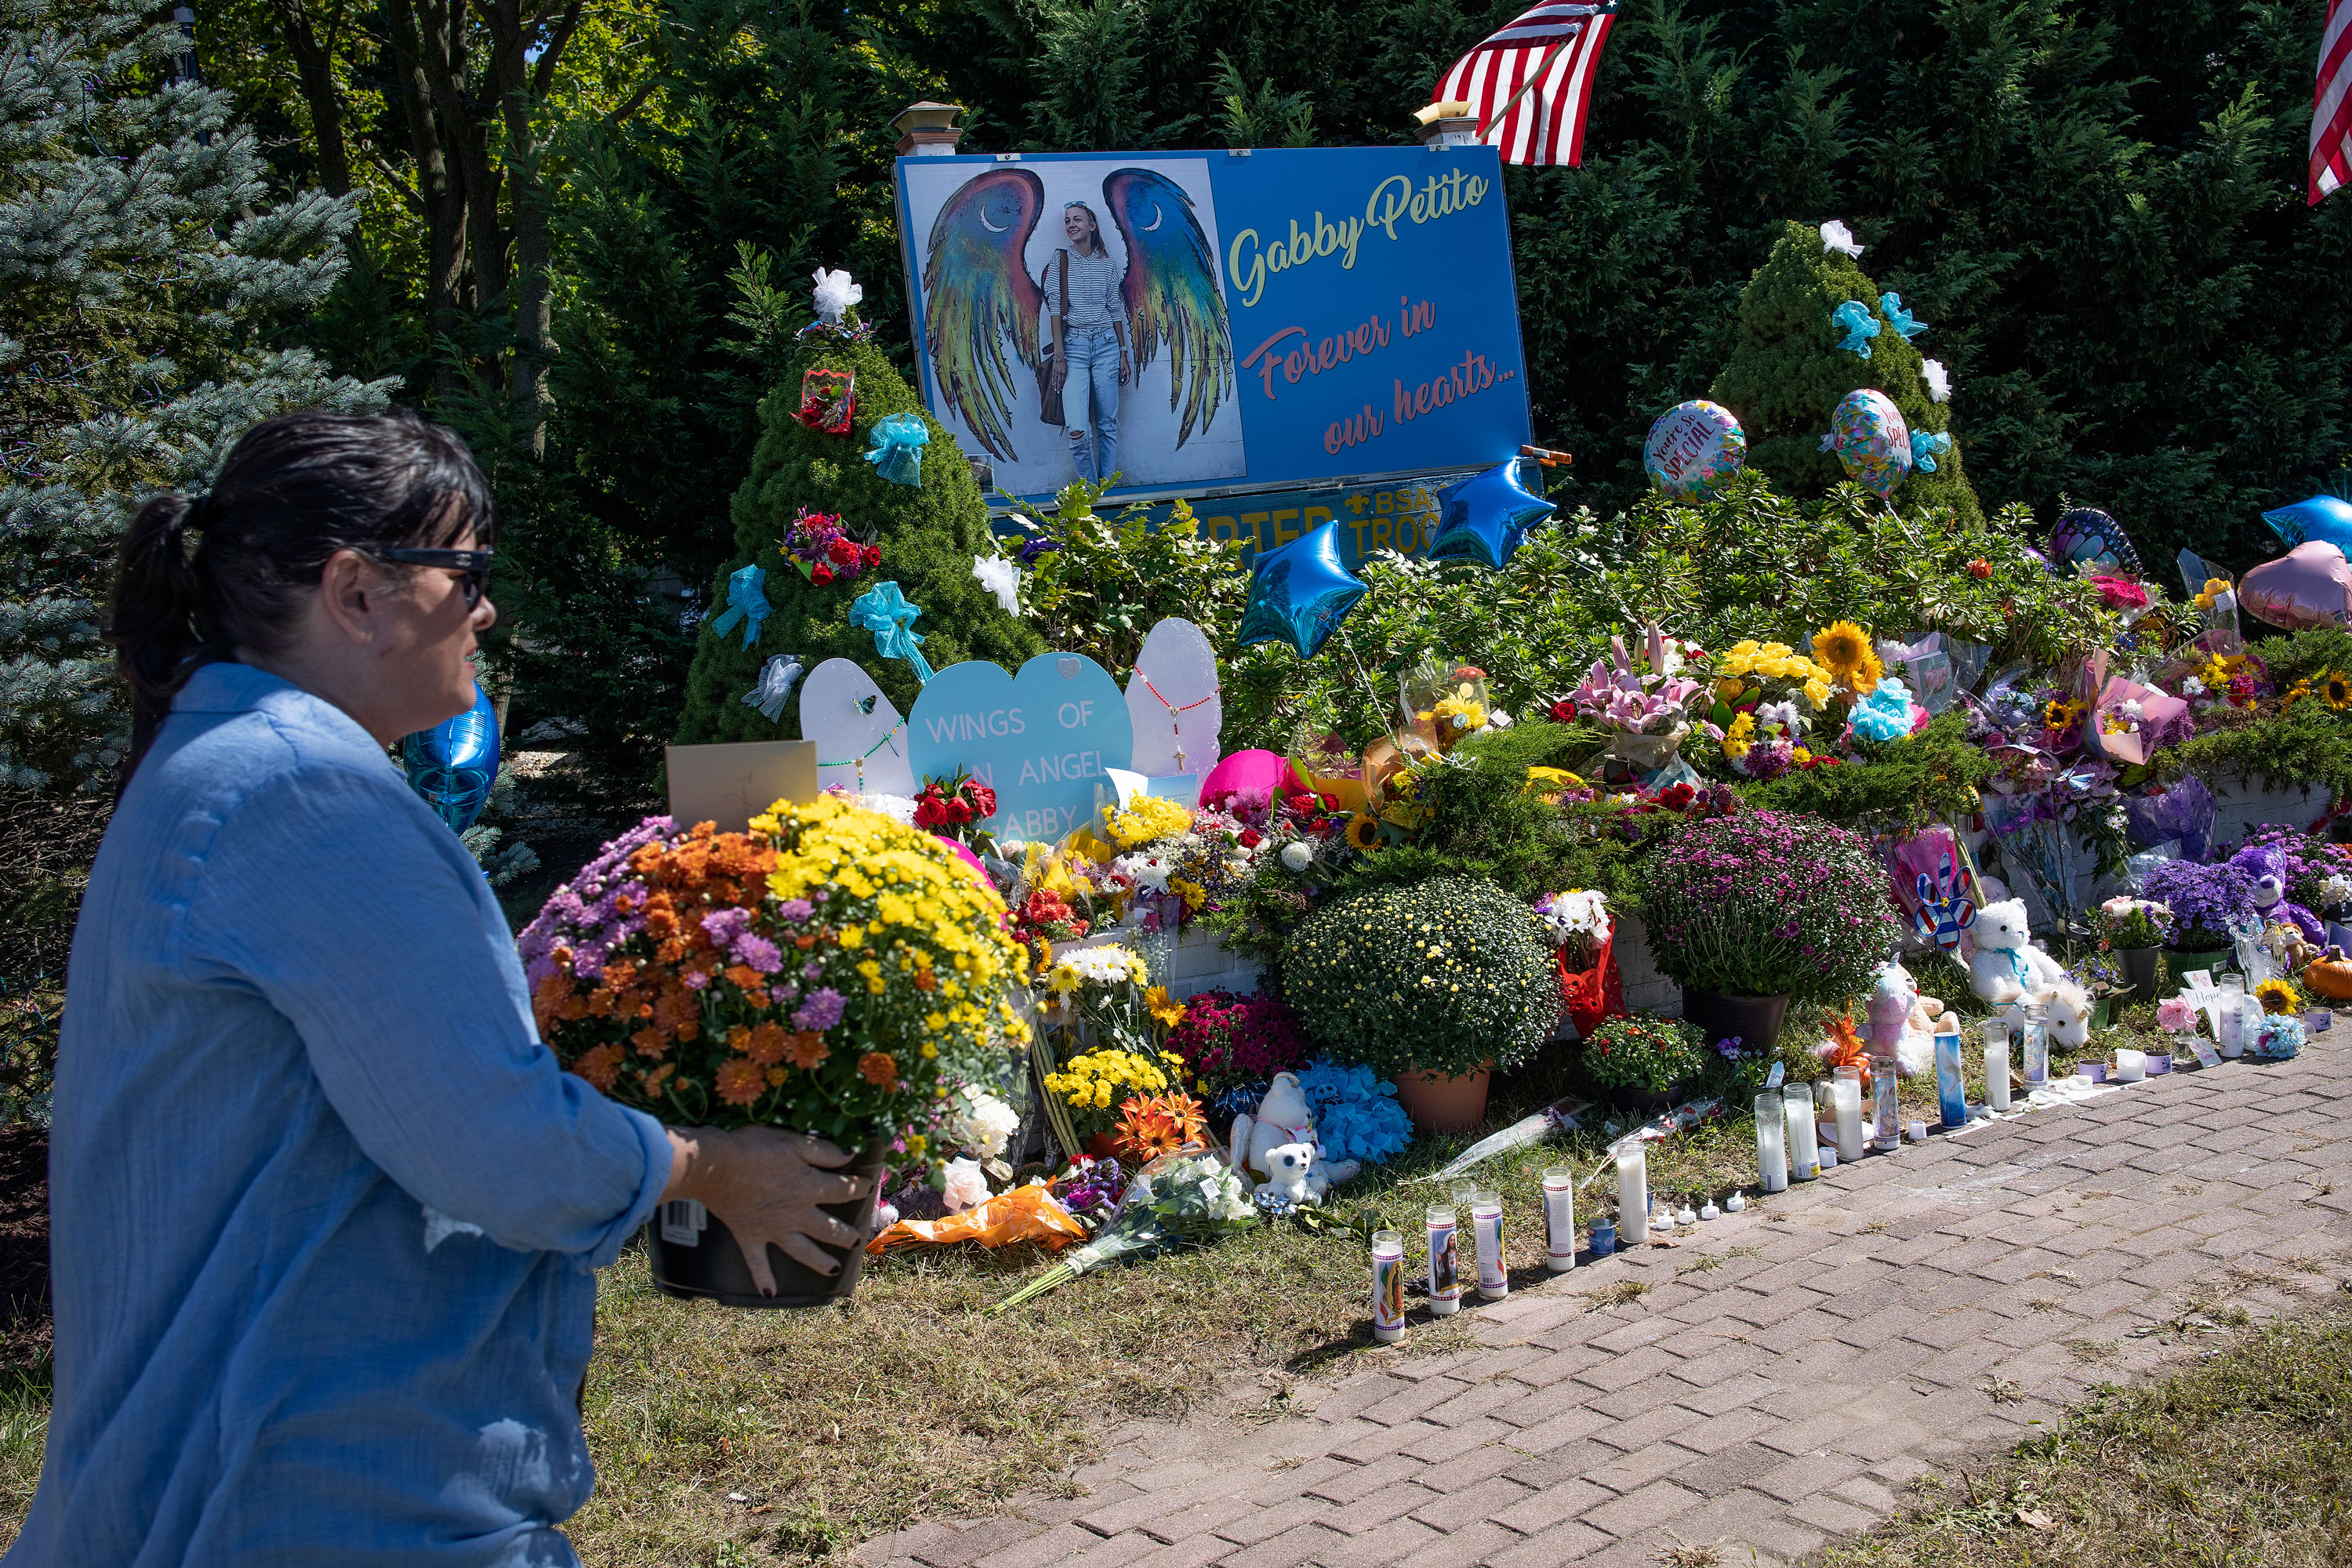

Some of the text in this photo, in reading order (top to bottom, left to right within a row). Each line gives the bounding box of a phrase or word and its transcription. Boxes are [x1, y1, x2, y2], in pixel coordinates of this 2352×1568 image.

[1229, 167, 1490, 307] Gabby Petito
[1240, 295, 1436, 401] Forever in
[1323, 350, 1515, 456] our hearts...
[1652, 414, 1696, 462] You're So
[1375, 487, 1432, 515] BSA
[1349, 511, 1441, 557] TROO
[924, 699, 1094, 744] WINGS OF
[1018, 750, 1109, 786] ANGEL
[982, 804, 1078, 841] GABBY
[2192, 991, 2221, 1004] Hope
